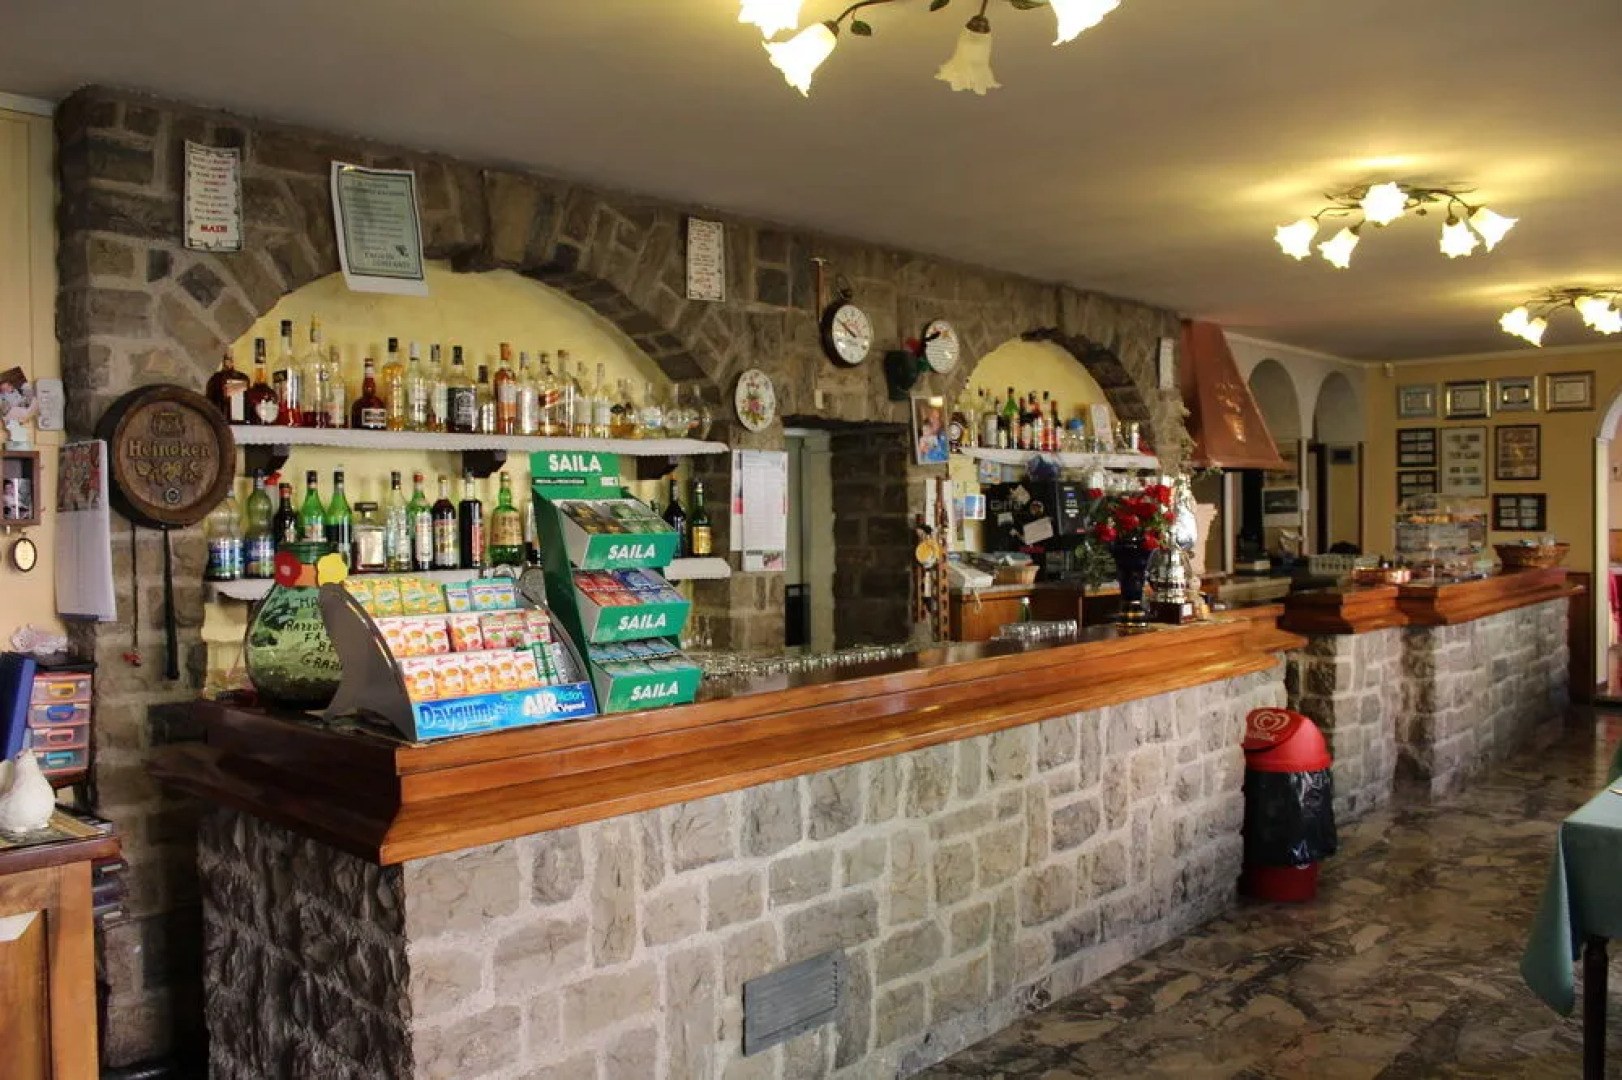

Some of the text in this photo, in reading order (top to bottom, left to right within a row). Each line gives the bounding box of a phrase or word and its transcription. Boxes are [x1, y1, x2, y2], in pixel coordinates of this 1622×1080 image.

[128, 439, 211, 458] Heineken
[548, 453, 602, 473] SAILA
[607, 544, 656, 561] SAILA
[617, 612, 667, 631] SAILA
[630, 681, 679, 701] SAILA
[522, 689, 558, 719] AIR
[418, 703, 490, 731] Daygum
